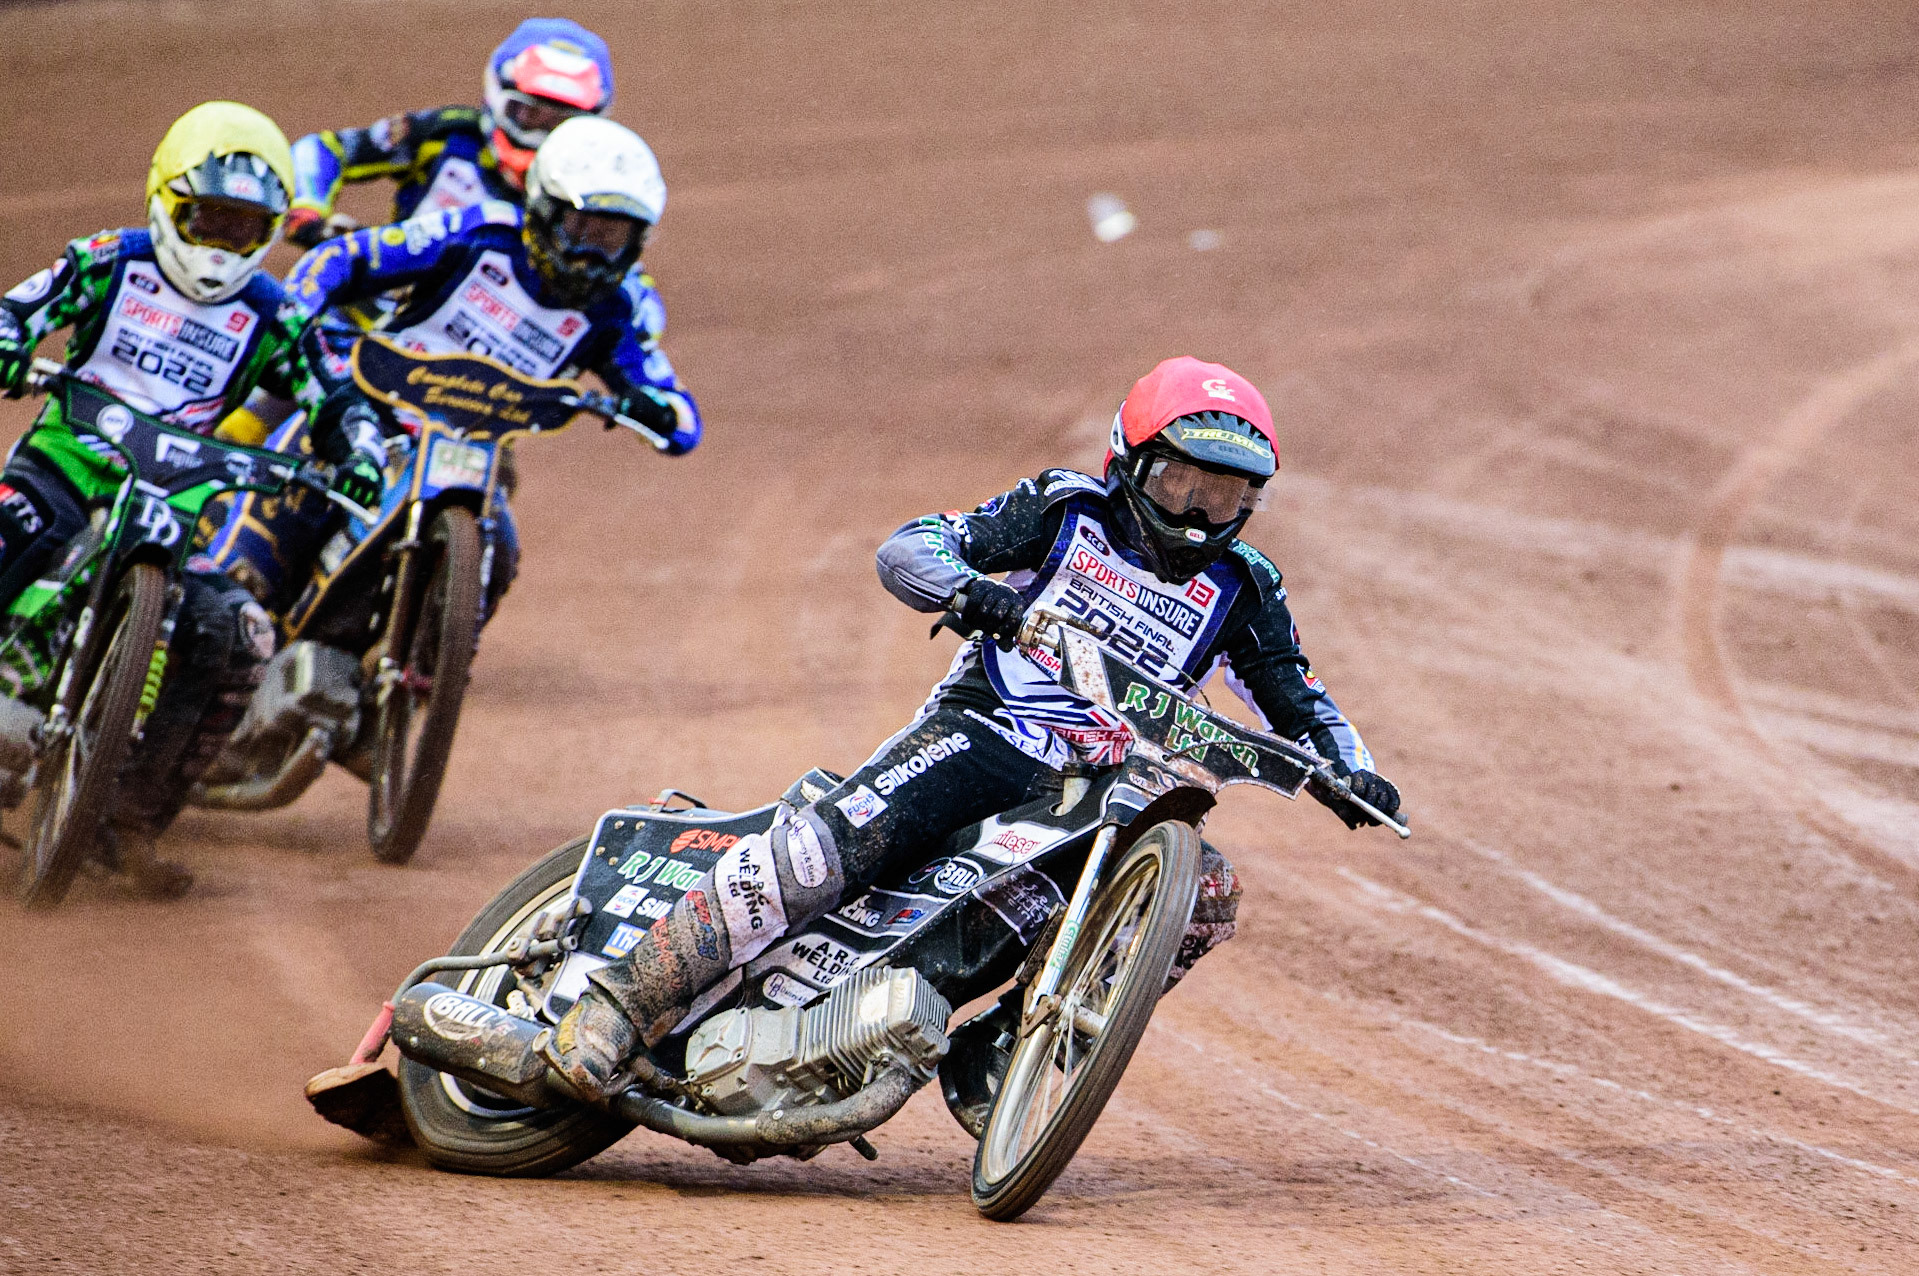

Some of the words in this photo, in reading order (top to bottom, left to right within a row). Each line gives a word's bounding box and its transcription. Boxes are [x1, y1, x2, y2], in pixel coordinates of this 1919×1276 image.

[121, 297, 183, 337] SPORTS
[111, 338, 213, 395] 2022
[1086, 532, 1106, 553] SCB
[1188, 531, 1206, 541] BELL
[1073, 550, 1139, 599] SPORTS
[1138, 589, 1200, 637] INSURE
[1184, 577, 1215, 608] 13
[1055, 588, 1170, 677] 2022
[1069, 578, 1135, 626] BRITISH
[1134, 619, 1175, 653] FINAL
[1029, 646, 1062, 672] RITISH
[1164, 723, 1210, 764] Ltd
[1174, 699, 1259, 771] Warren
[873, 731, 971, 797] Silkolene
[846, 793, 875, 818] FUCHS
[653, 858, 707, 892] War
[727, 874, 741, 898] Ltd
[738, 847, 763, 931] WELDING
[942, 861, 978, 888] BALL
[812, 970, 835, 986] Ltd
[430, 995, 499, 1029] BALL
